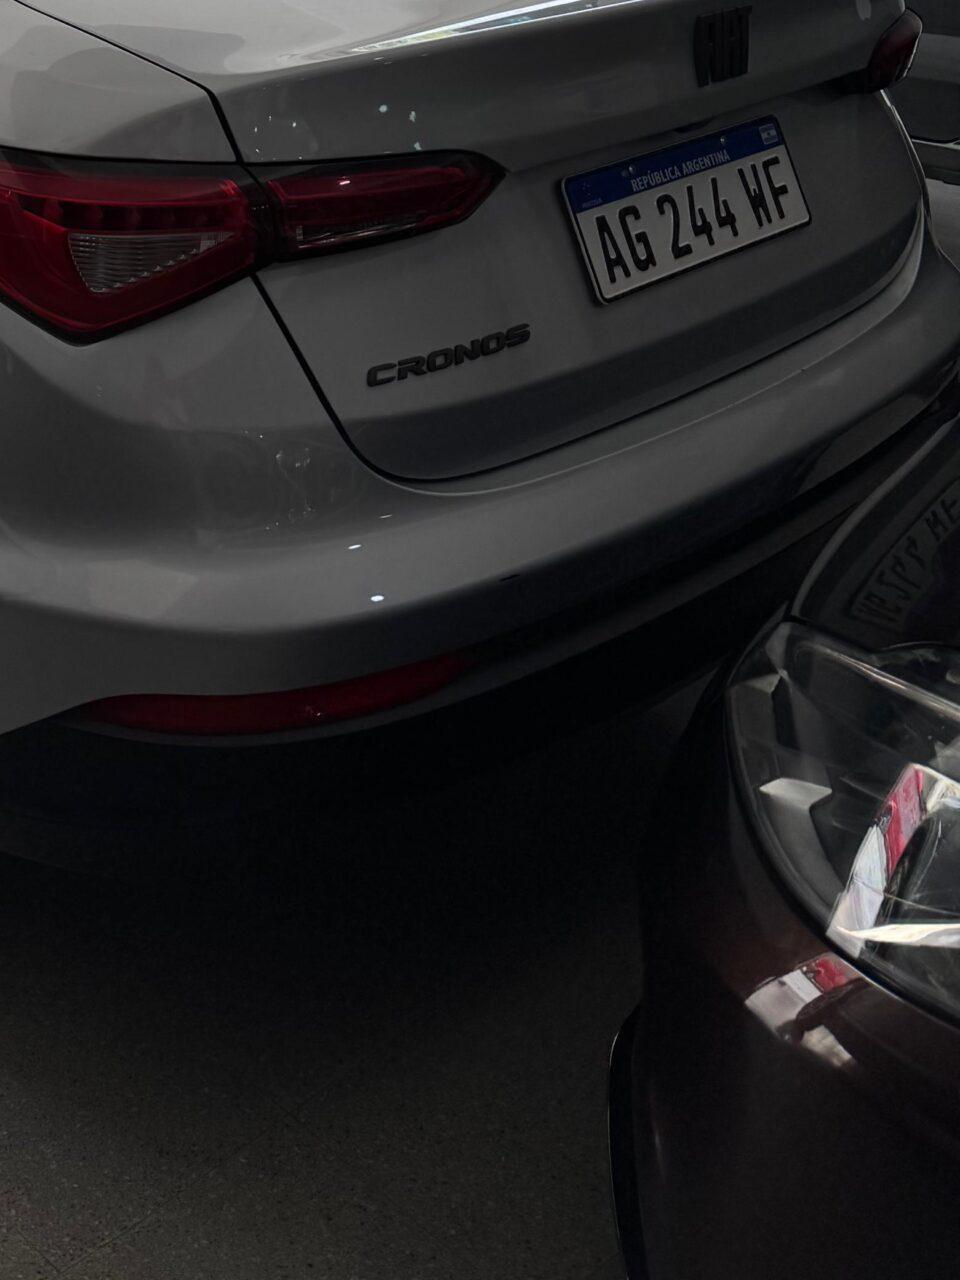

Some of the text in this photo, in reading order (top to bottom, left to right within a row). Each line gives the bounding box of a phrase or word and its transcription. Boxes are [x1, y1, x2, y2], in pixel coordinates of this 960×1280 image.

[630, 148, 731, 193] REPÚBLICA ARGENTINA
[595, 156, 789, 284] AG 244 WF
[366, 323, 531, 387] CRONOS
